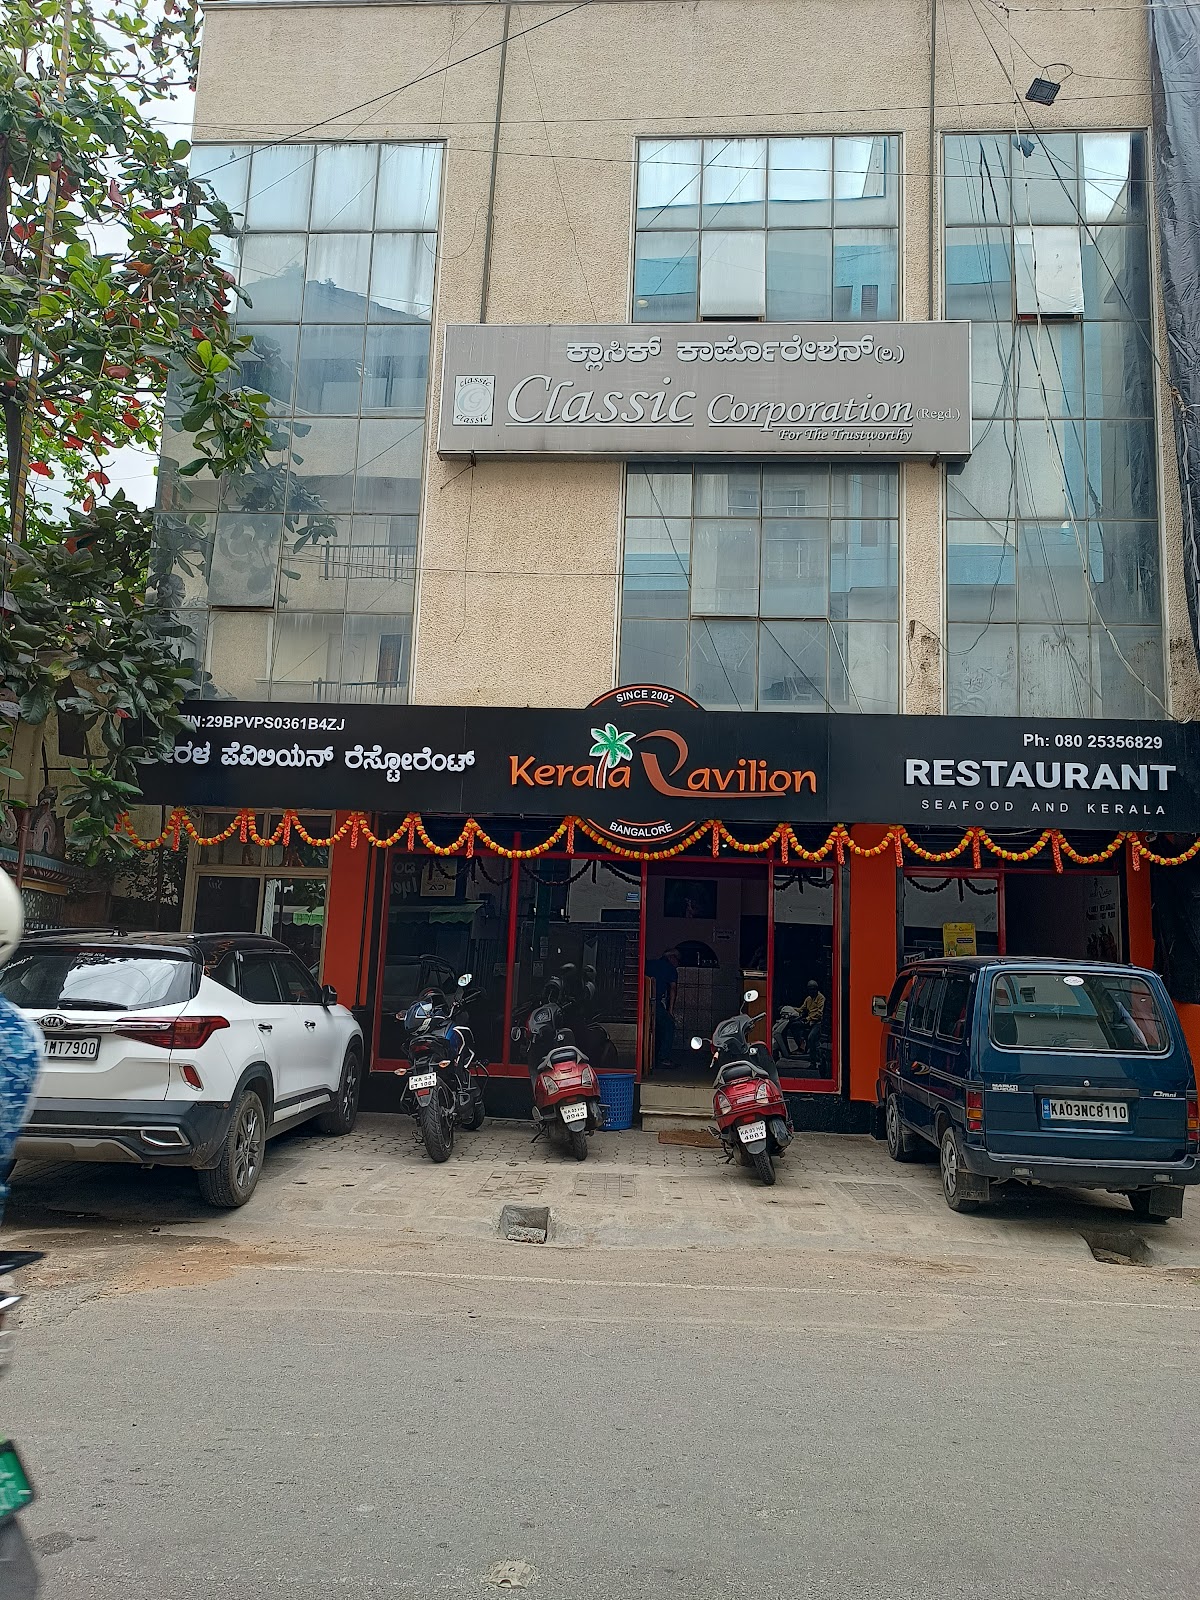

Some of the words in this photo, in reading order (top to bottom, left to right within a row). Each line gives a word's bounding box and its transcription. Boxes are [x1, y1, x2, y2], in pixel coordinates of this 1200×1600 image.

[565, 335, 662, 371] ಕ್ಲಾಸಿಕ್
[507, 374, 697, 423] Classic
[707, 392, 914, 432] Corporation
[916, 408, 961, 421] (Regd.)
[778, 428, 803, 441] For
[804, 428, 828, 441] The
[830, 428, 912, 444] Trustworthy
[616, 690, 648, 703] SINCE
[650, 690, 675, 704] 2002
[1023, 734, 1051, 747] Ph:
[1054, 734, 1083, 748] 080
[1087, 735, 1163, 749] 25356829
[509, 745, 632, 789] Kerala
[636, 729, 817, 798] Pavilion
[905, 759, 1177, 791] RESTAURANT
[921, 799, 1014, 812] SEAFOOD
[1031, 802, 1069, 813] AND
[1088, 803, 1165, 815] KERALA
[609, 821, 673, 837] BANGALORE
[43, 1017, 61, 1027] KIA
[1153, 1090, 1177, 1098] Omni
